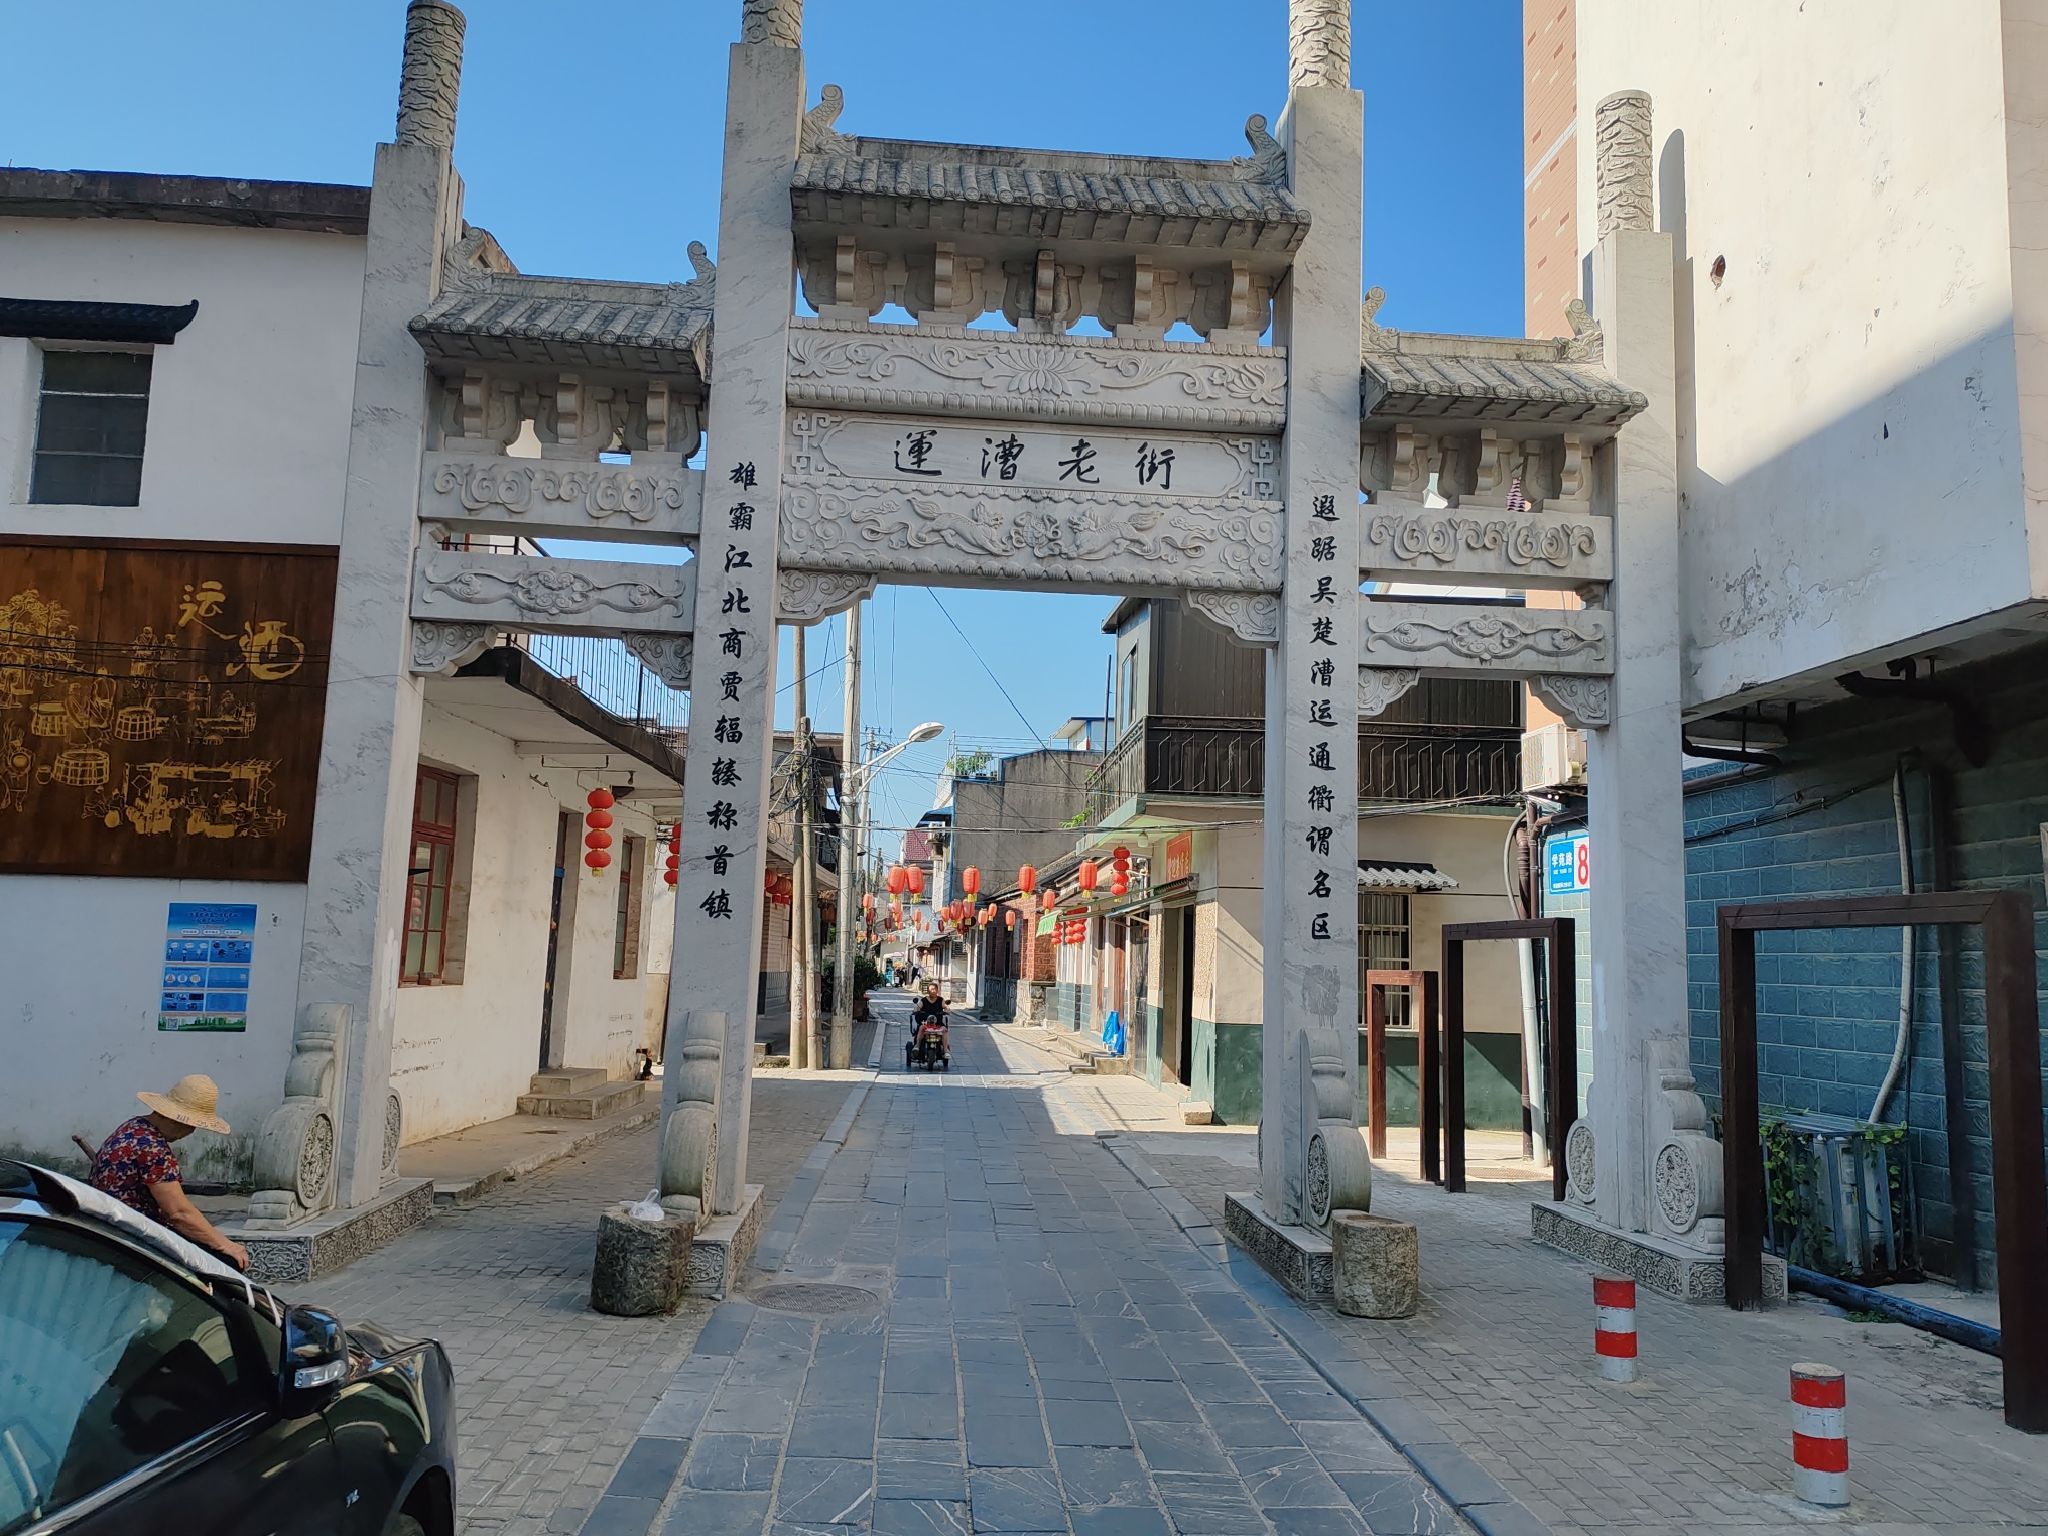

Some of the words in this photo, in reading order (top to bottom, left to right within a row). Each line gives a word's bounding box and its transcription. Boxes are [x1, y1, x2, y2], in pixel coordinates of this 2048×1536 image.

[893, 429, 1176, 490] 運漕老街
[699, 461, 759, 920] 雄霸江北商贾辐辏称首镇
